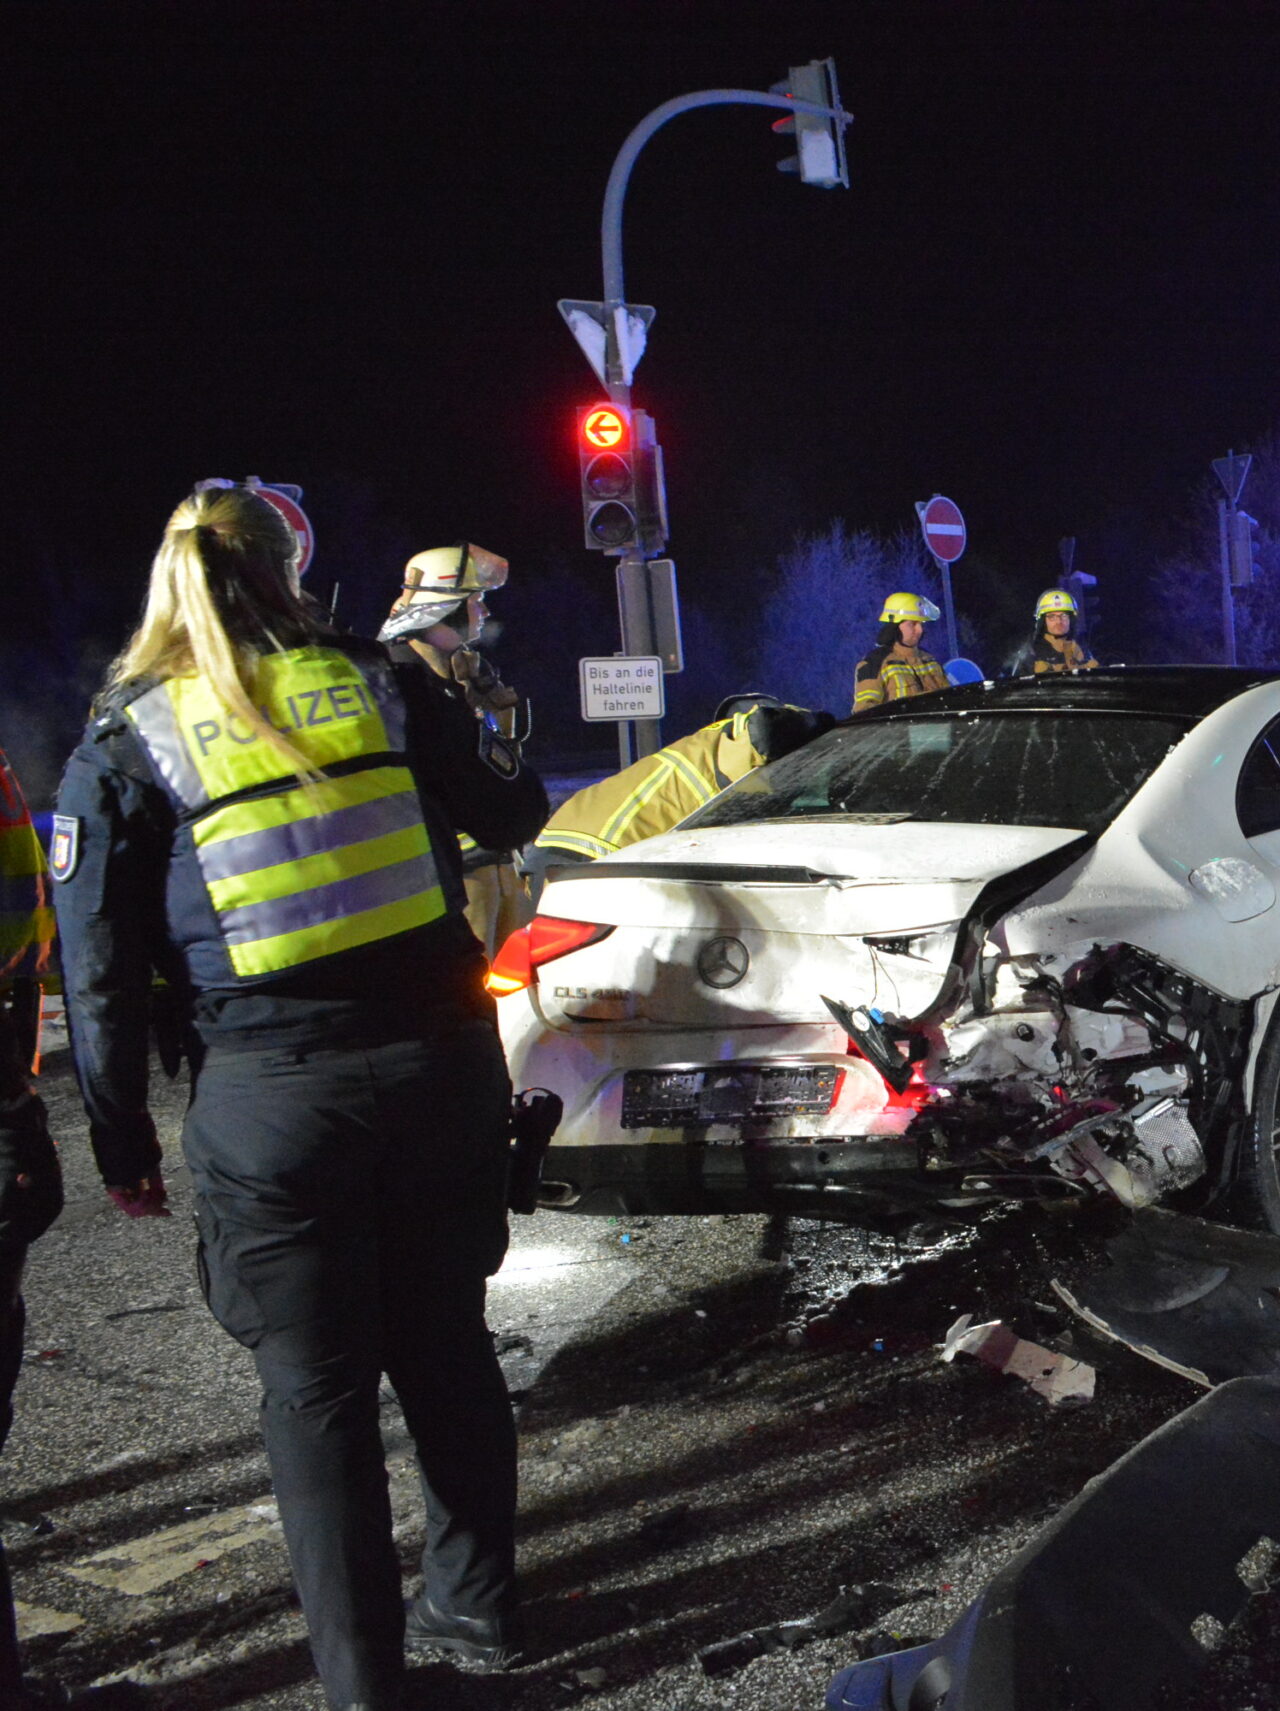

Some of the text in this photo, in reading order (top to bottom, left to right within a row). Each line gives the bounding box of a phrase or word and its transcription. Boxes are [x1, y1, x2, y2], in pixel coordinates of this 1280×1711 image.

[589, 665, 655, 679] Bis an die
[592, 682, 653, 695] Haltelinie
[603, 699, 646, 711] fahren
[191, 683, 372, 756] POLIZEI
[554, 986, 588, 999] CLS
